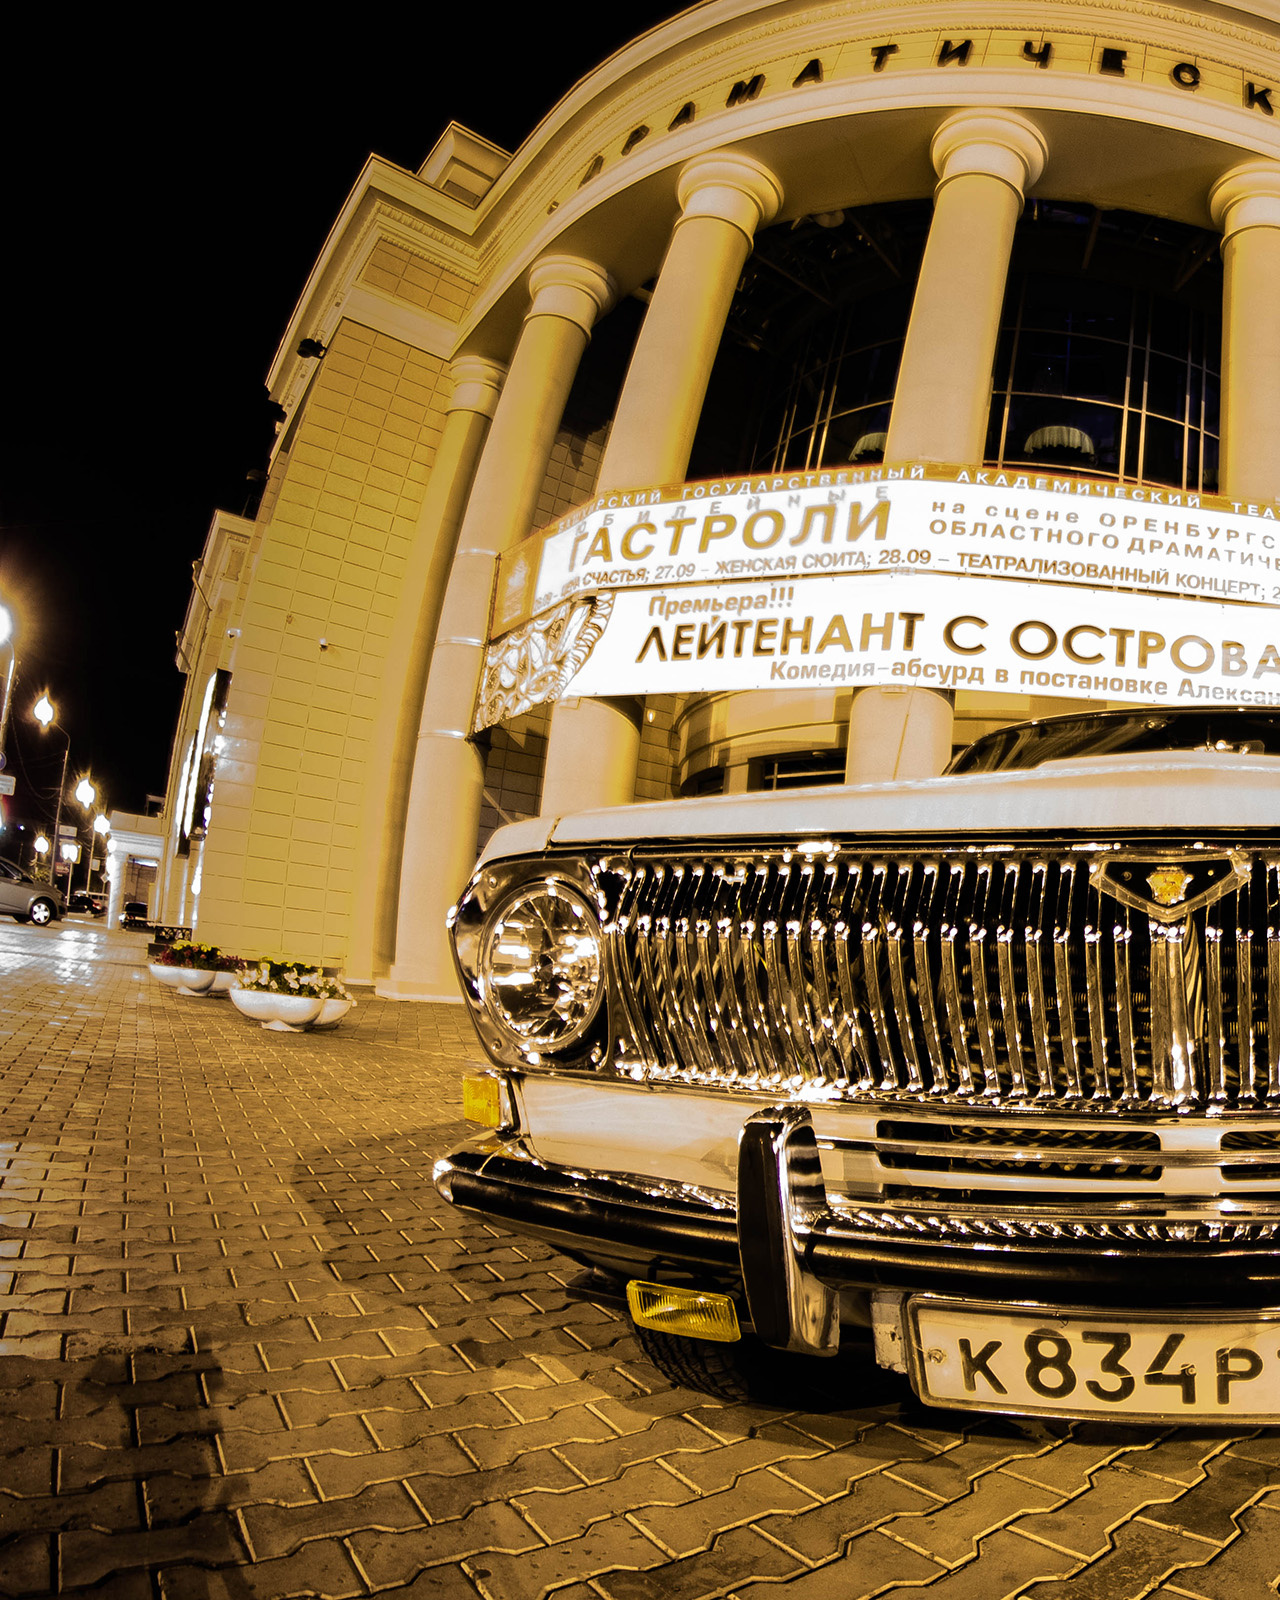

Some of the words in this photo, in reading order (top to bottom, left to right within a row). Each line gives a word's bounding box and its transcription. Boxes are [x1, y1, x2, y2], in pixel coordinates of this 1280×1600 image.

[682, 465, 925, 500] ГОСУДАРСТВЕННЫЙ
[956, 470, 1201, 509] АКАДЕМИЧЕСКИЙ
[575, 485, 890, 537] ЮБИЛЕЙНЫЕ
[931, 501, 966, 515] на
[985, 504, 1080, 524] сцене
[568, 500, 892, 573] ГАСТРОЛИ
[929, 518, 1120, 550] ОБЛАСТНОГО
[582, 567, 650, 587] СЧАСТЬЯ;
[656, 563, 696, 580] 27.09
[714, 555, 797, 575] ЖЕНСКАЯ
[802, 551, 872, 570] СЮИТА;
[878, 548, 932, 565] 28.09
[956, 551, 1169, 585] ТЕАТРАЛИЗОВАННЫЙ
[1175, 572, 1266, 601] КОНЦЕРТ;
[648, 586, 794, 621] Премьера!!!
[635, 611, 925, 664] ЛЕЙТЕНАНТ
[943, 615, 990, 656] С
[994, 668, 1009, 683] в
[1019, 670, 1168, 696] постановке
